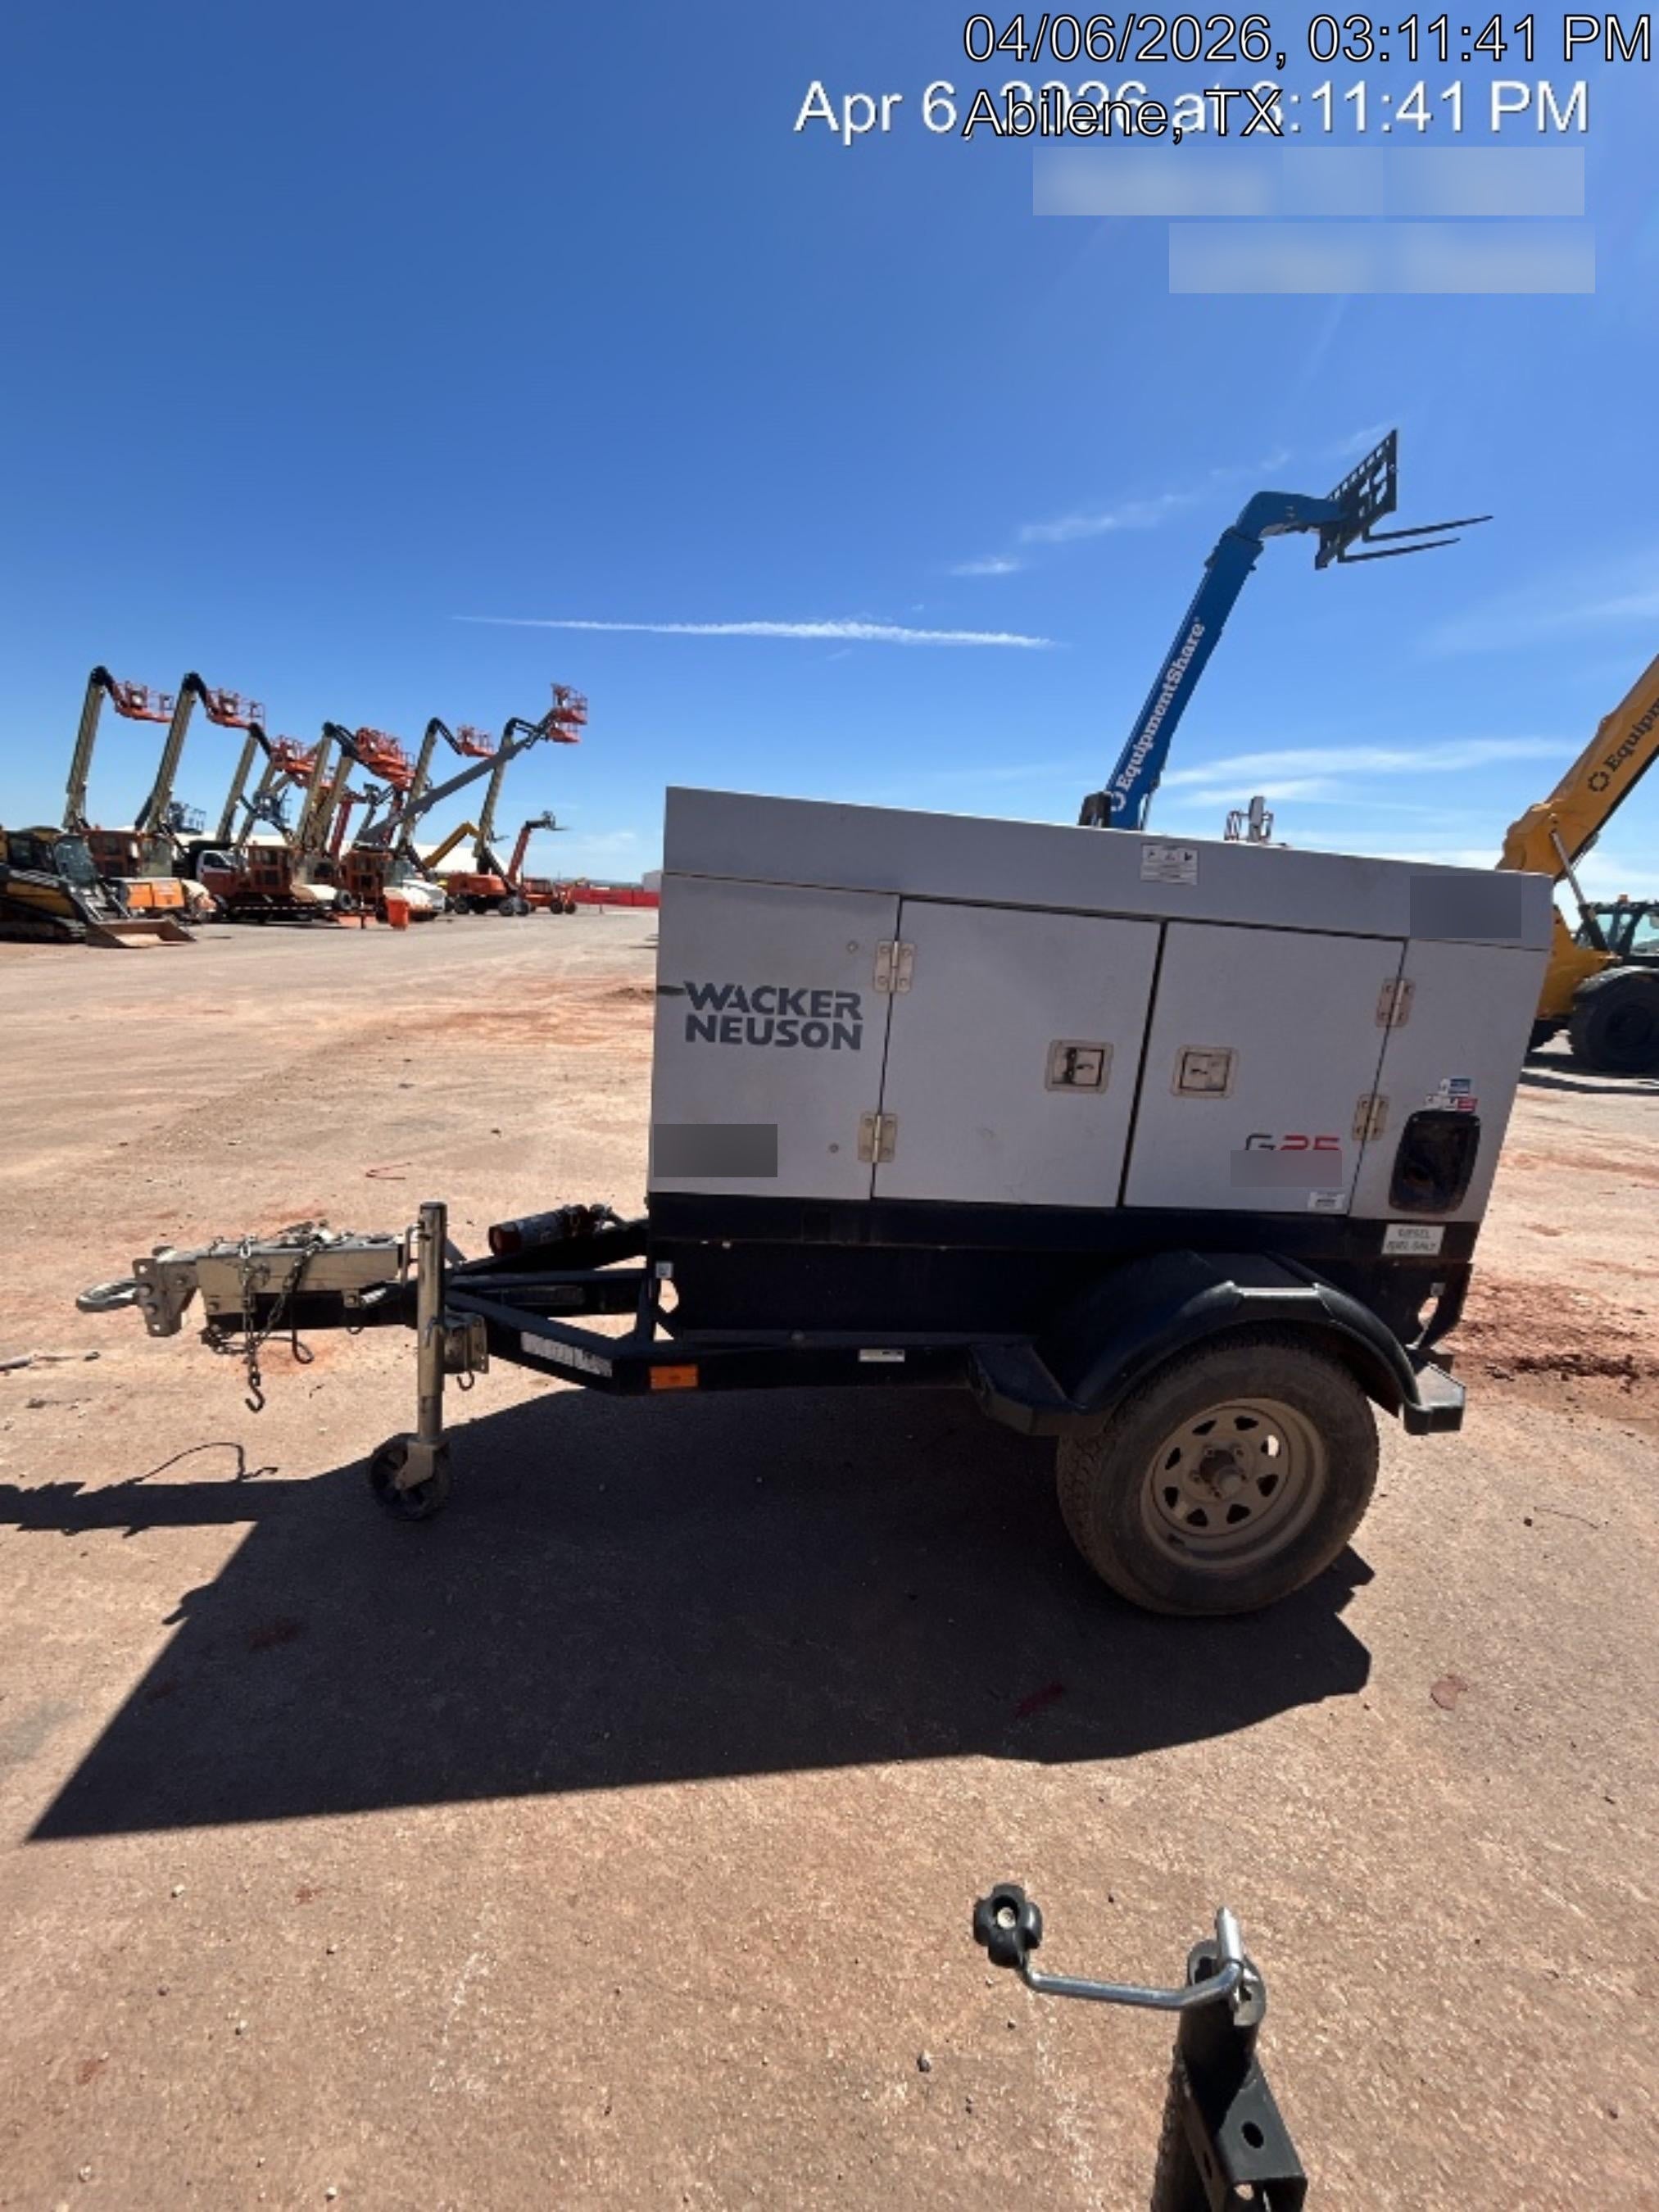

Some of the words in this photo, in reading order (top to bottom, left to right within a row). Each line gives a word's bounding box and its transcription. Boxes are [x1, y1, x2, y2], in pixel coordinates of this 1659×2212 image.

[1115, 621, 1206, 792] EquipmentShare
[683, 980, 863, 1020] WACKER
[685, 1013, 863, 1050] NEUSON
